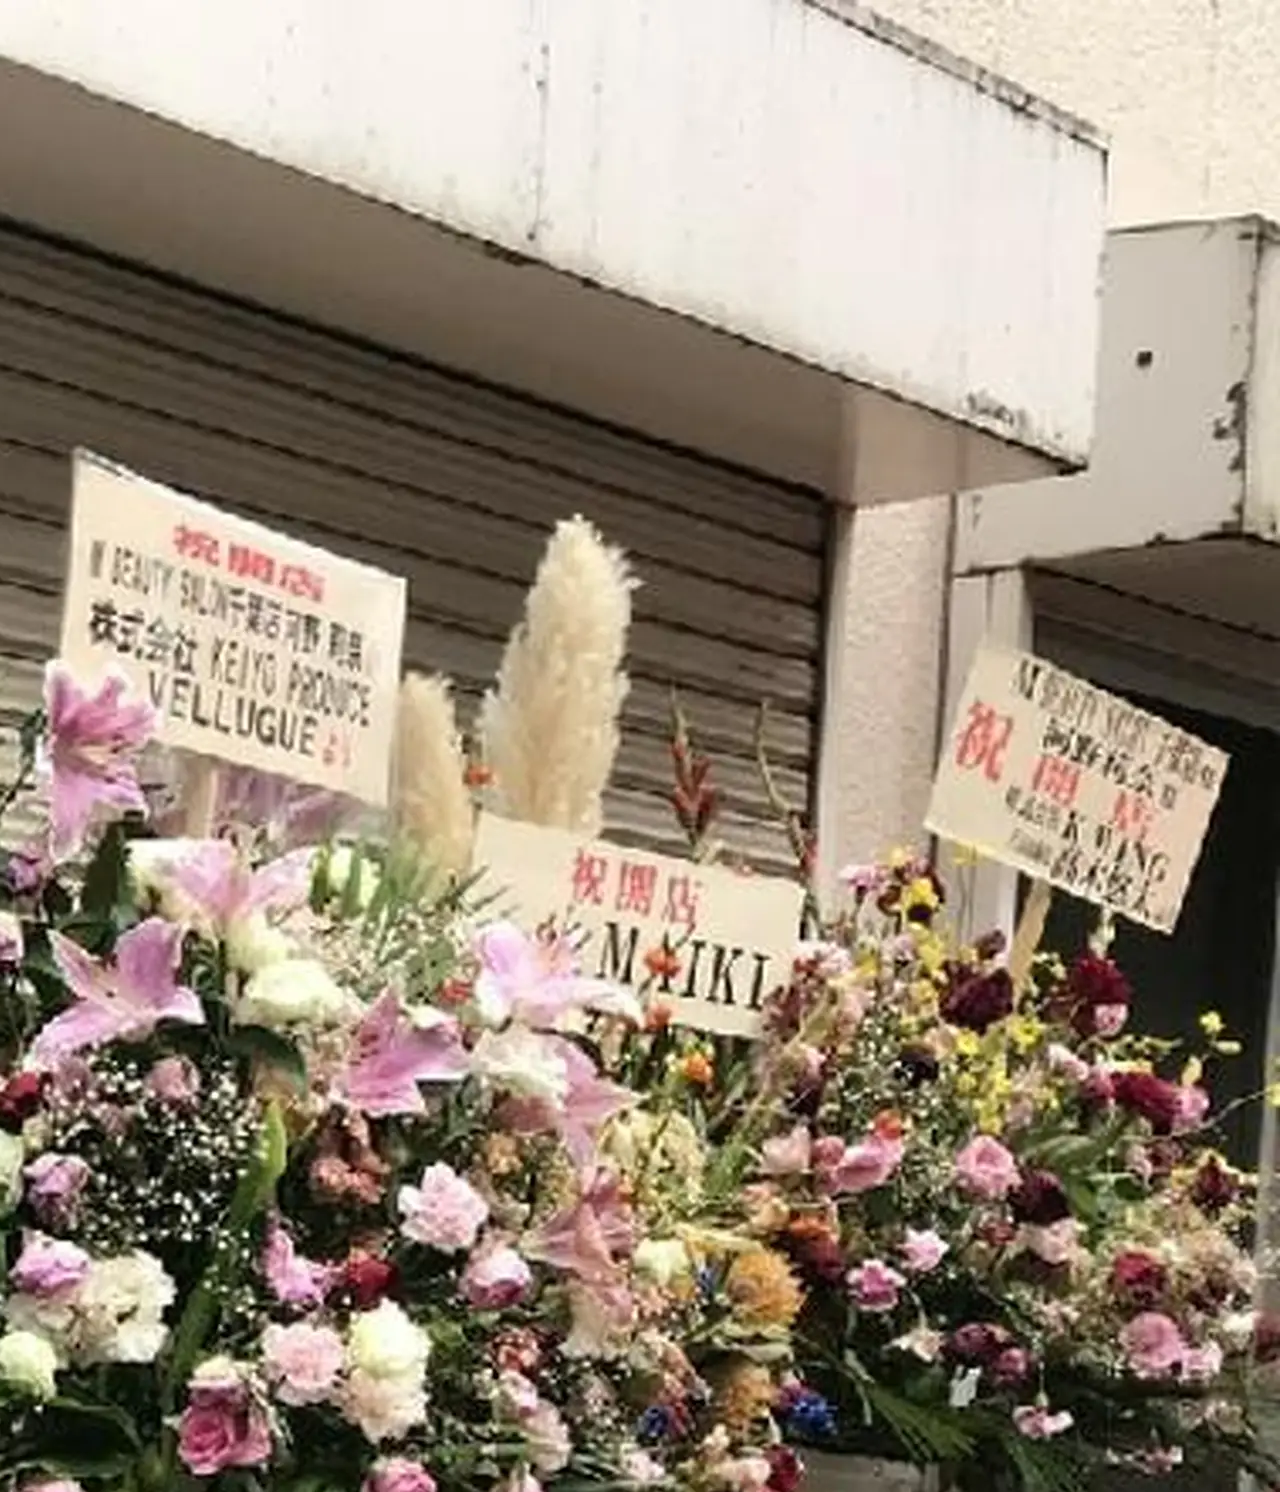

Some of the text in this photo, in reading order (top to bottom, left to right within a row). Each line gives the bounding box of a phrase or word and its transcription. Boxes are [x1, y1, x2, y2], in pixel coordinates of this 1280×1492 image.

[171, 524, 325, 602] 祝開店
[89, 597, 199, 673] 株式会社
[148, 671, 319, 758] VELLUGUE
[571, 848, 703, 936] 祝開店
